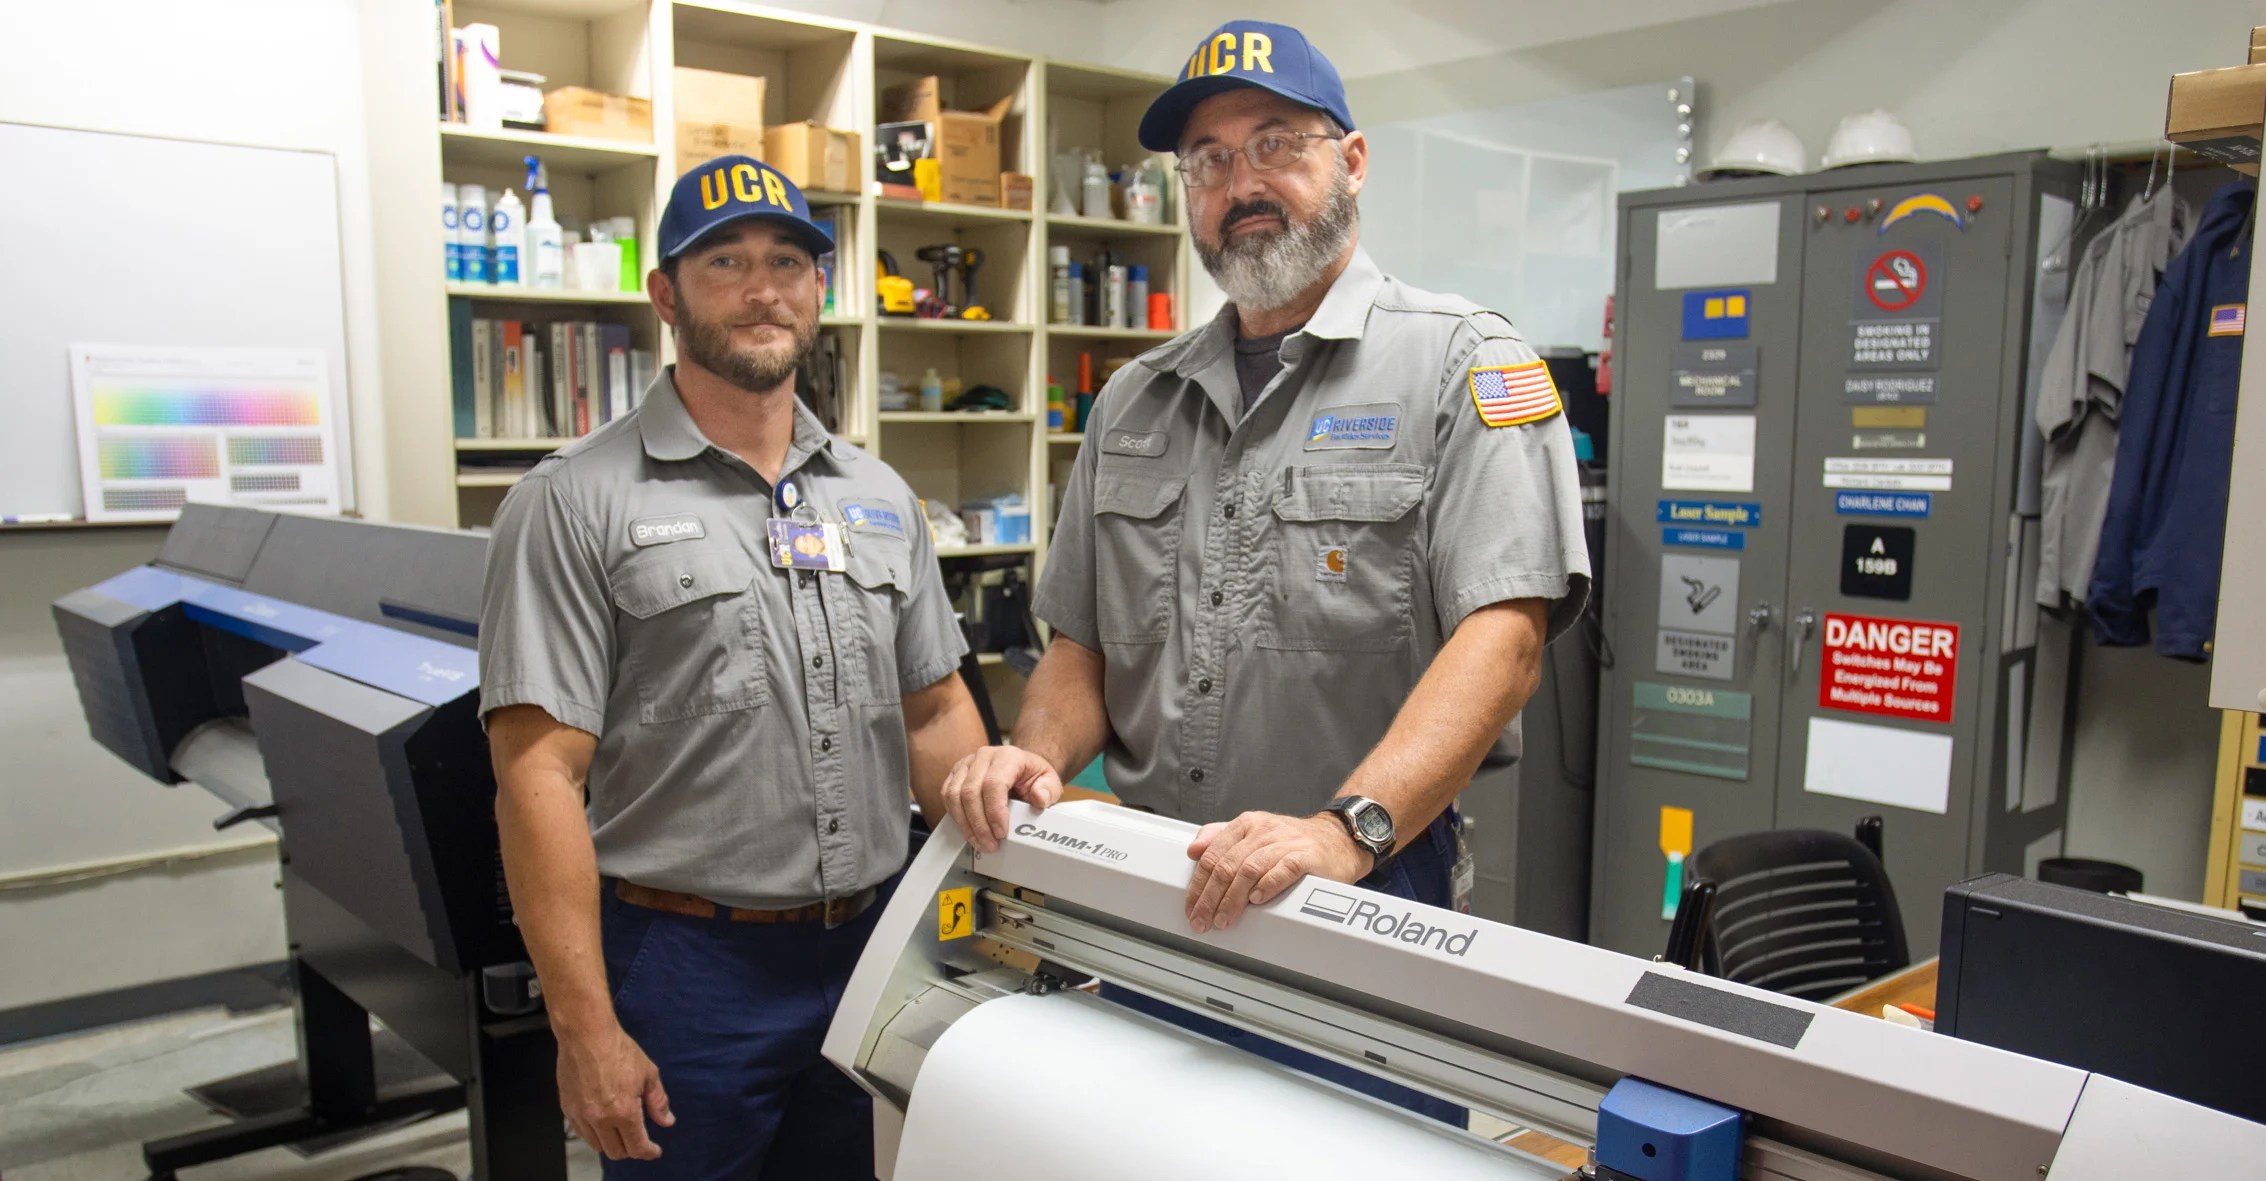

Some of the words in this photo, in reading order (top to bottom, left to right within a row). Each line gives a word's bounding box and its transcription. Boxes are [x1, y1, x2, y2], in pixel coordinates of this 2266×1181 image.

[1187, 32, 1275, 79] UCR
[700, 164, 793, 213] UCR
[1857, 324, 1913, 338] SMOKING
[1916, 324, 1930, 336] IN
[1854, 336, 1931, 350] DESIGNATED
[1854, 348, 1894, 362] AREAS
[1896, 348, 1930, 361] ONLY
[1679, 375, 1742, 387] MECHANICAL
[1875, 378, 1934, 392] RODRIGUEZ
[1694, 386, 1726, 397] ROOM
[1314, 419, 1332, 434] UC
[1333, 416, 1396, 432] RIVERSIDE
[1360, 432, 1391, 440] Services
[1838, 494, 1894, 511] CHARLENE
[1895, 496, 1927, 512] CHAN
[1670, 503, 1702, 520] Laser
[1704, 504, 1749, 525] Sample
[1870, 536, 1885, 554] A
[1856, 556, 1898, 576] 159B
[1664, 635, 1729, 651] DESIGNATED
[1825, 617, 1954, 659] DANGER
[1673, 647, 1719, 661] SMOKING
[1682, 659, 1708, 671] AREA
[1832, 650, 1892, 671] Switches
[1893, 656, 1922, 677] May
[1923, 659, 1944, 677] Be
[1834, 668, 1901, 690] Energized
[1901, 676, 1939, 694] From
[1666, 687, 1715, 706] 0303A
[1830, 686, 1882, 707] Multiple
[1883, 692, 1940, 714] Sources
[1347, 900, 1478, 957] Roland
